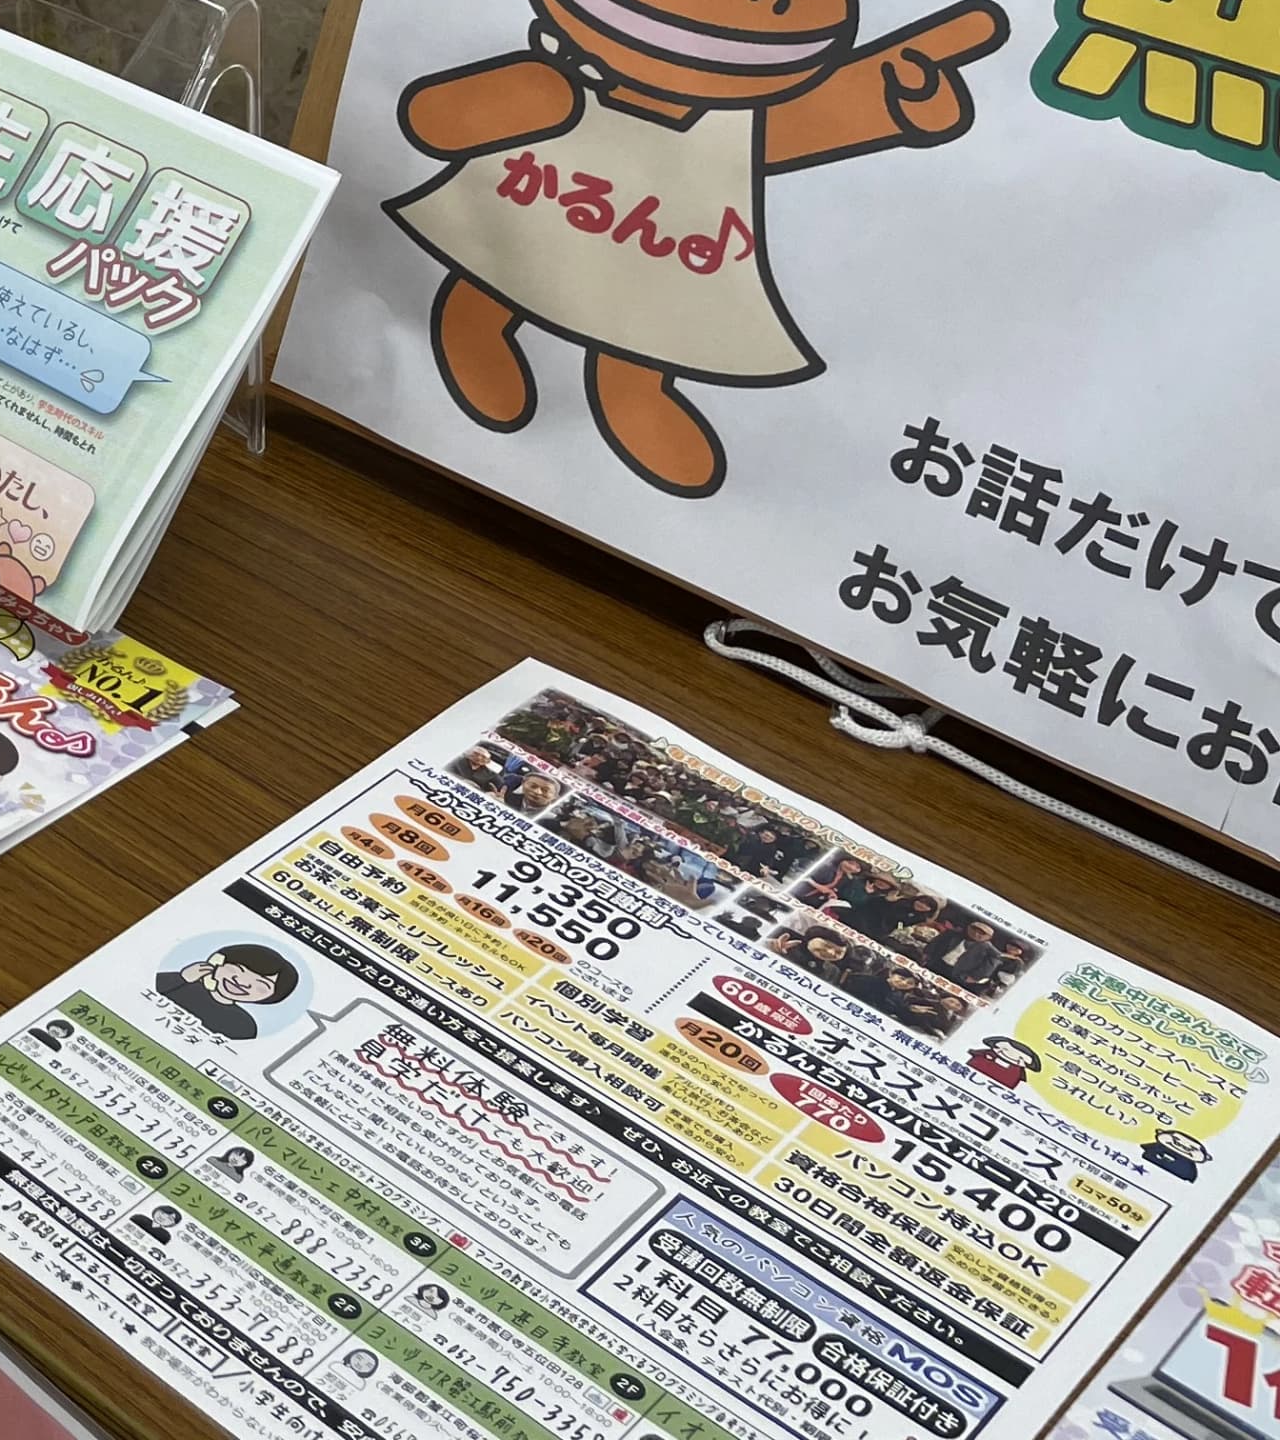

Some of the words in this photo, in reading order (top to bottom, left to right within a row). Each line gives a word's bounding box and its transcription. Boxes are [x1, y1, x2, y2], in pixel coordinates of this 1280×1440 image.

[48, 242, 202, 328] パック
[382, 821, 436, 855] 月8回
[406, 804, 462, 837] 月6回
[319, 840, 408, 895] 自由予約
[507, 859, 641, 941] 9,350
[469, 869, 621, 962] 11,550
[526, 994, 663, 1080] イベント毎月開催
[553, 980, 655, 1043] 個別学習
[681, 1022, 762, 1072] 月20回
[1045, 1032, 1195, 1116] 飲みながらホッと
[1046, 1053, 1174, 1127] 一息つけるのも
[1050, 1014, 1218, 1107] お菓子やコーヒーを
[795, 1093, 852, 1132] 770
[784, 1150, 949, 1252] 資格合格保証
[835, 1148, 1050, 1277] パソコン持込OK
[892, 1137, 1073, 1254] 15,400
[1072, 1178, 1144, 1223] 1コマ50分
[771, 1175, 1034, 1340] 30日間全額返金保証
[655, 1233, 812, 1341] 受講回数無制限
[822, 1338, 962, 1434] 合格保証付き
[744, 1326, 874, 1419] 77,000
[885, 1338, 986, 1409] MOS
